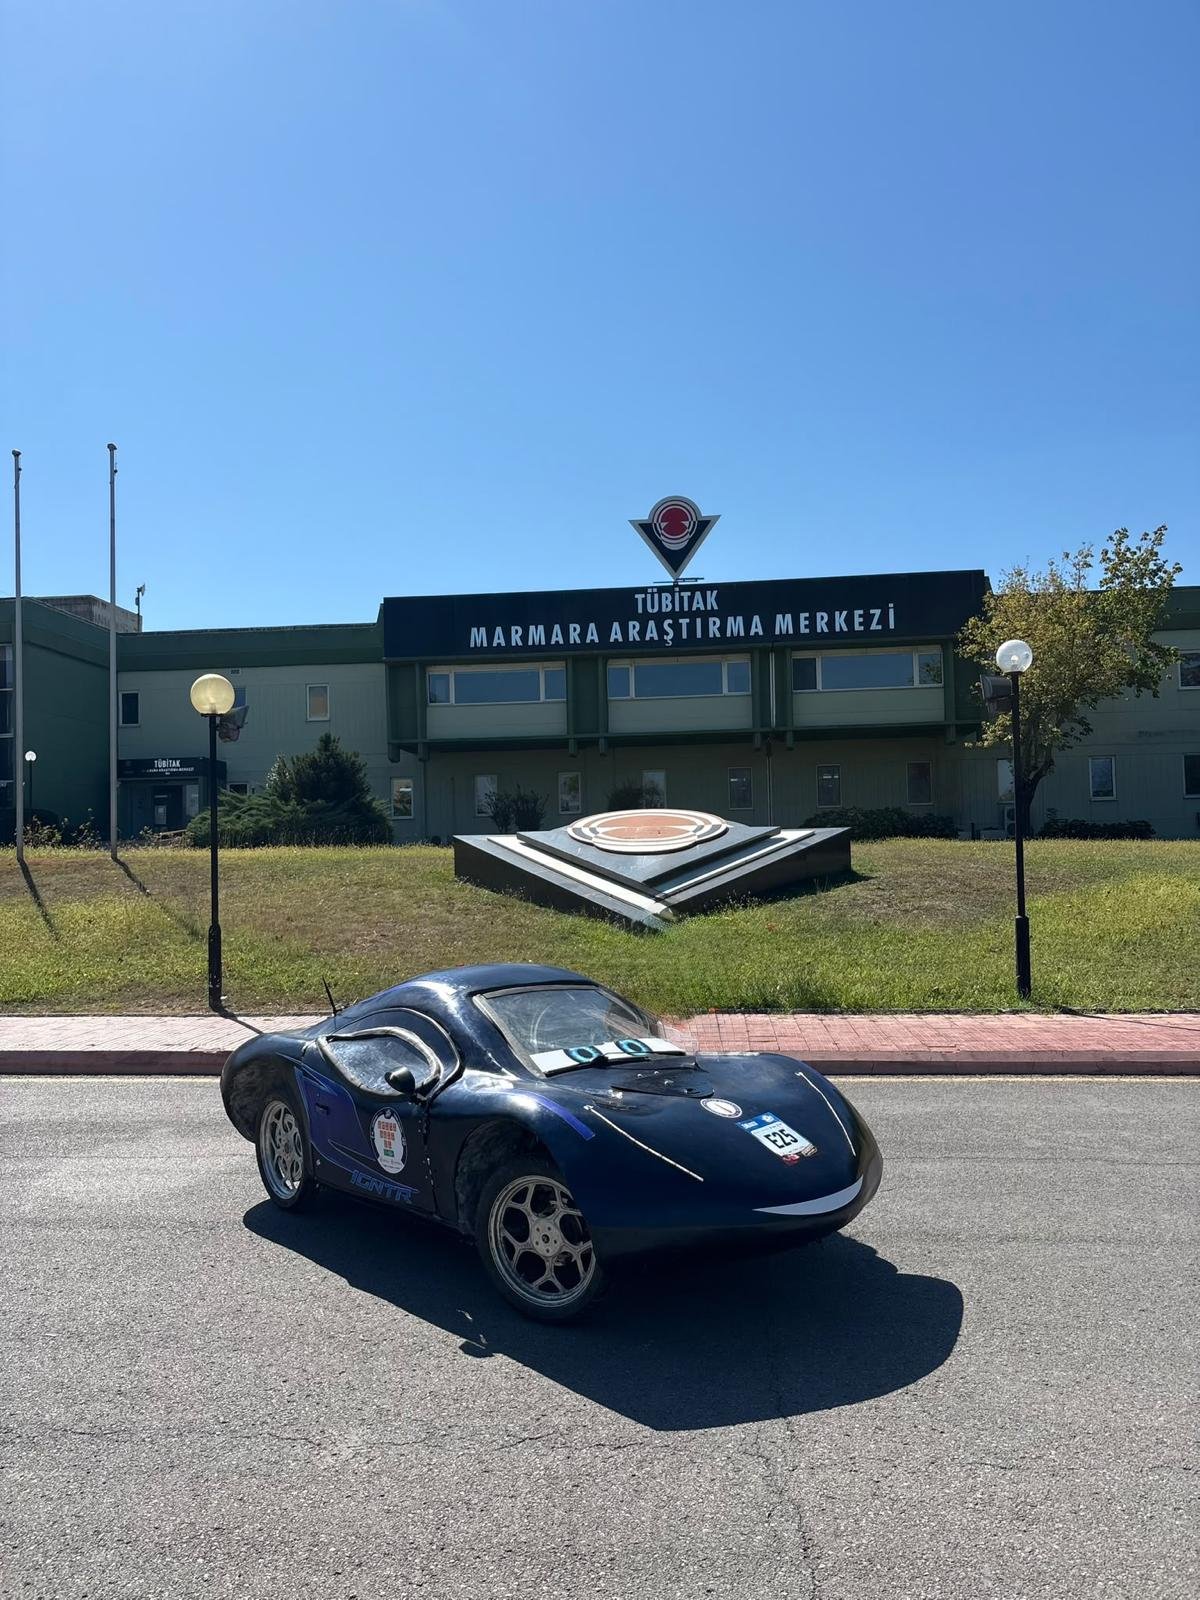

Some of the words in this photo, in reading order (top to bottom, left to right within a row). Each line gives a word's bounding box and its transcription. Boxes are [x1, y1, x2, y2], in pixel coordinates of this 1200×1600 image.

[634, 587, 719, 615] TÜBİTAK
[469, 622, 600, 648] MARMARA
[609, 615, 764, 646] ARAŞTIRMA
[774, 602, 896, 635] MERKEZİ
[154, 758, 181, 768] TÜBİTAK
[764, 1128, 799, 1149] E25
